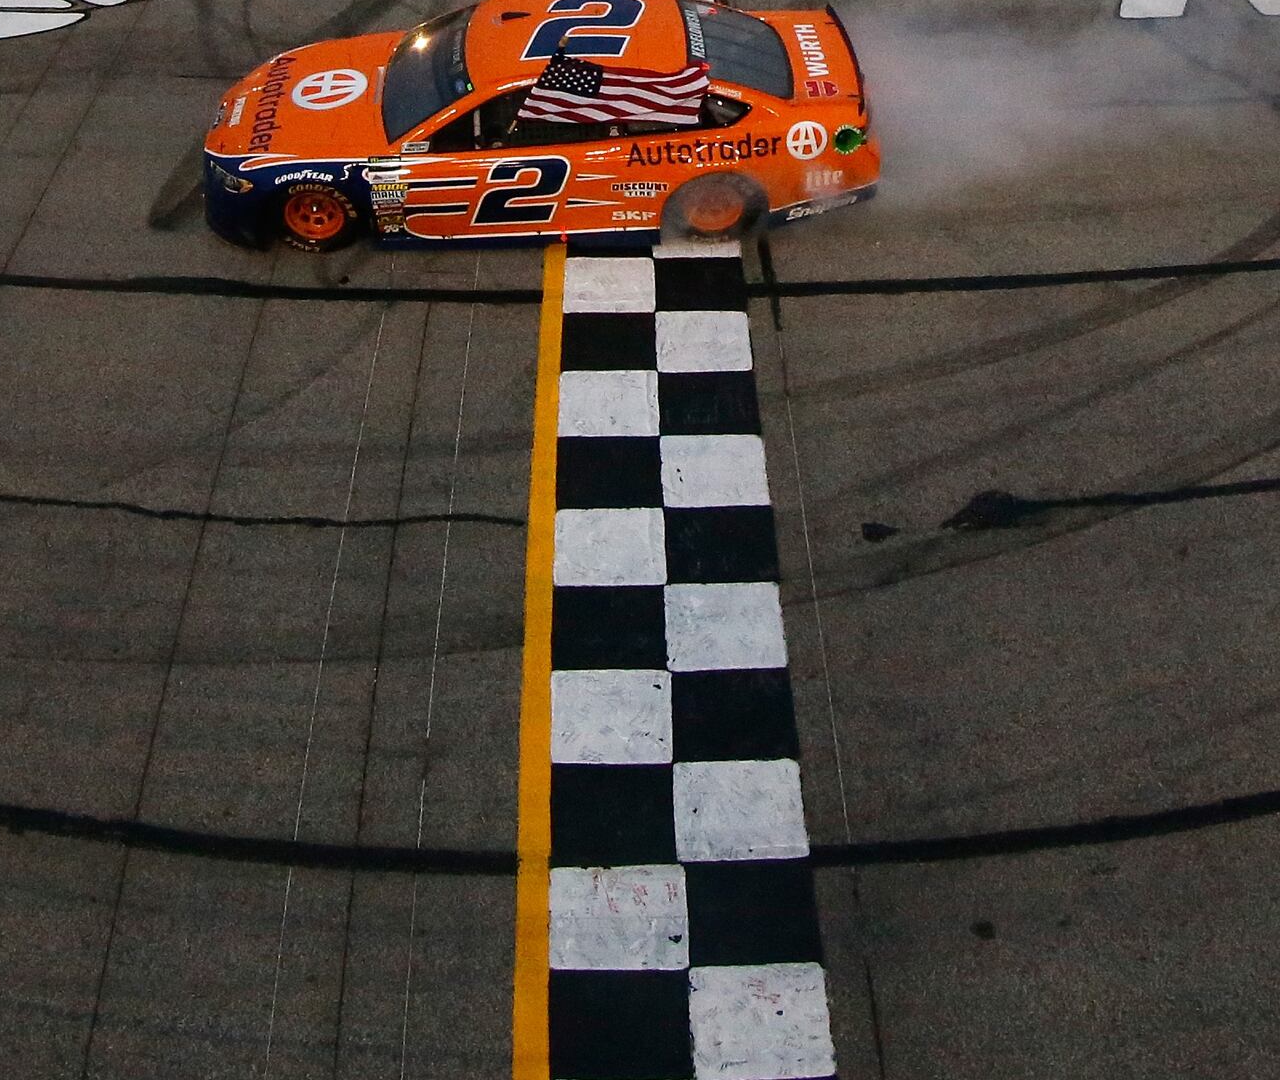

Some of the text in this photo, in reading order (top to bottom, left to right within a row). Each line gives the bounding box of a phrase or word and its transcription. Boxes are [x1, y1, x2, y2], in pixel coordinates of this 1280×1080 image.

[794, 23, 830, 78] WÜRTH
[248, 56, 297, 153] Autotrader
[627, 132, 782, 168] Autotrader
[274, 169, 334, 185] GOODYEAR
[371, 183, 408, 191] MOOG
[611, 182, 669, 193] DISCOUNT
[472, 156, 570, 227] 2
[611, 210, 657, 222] SKF
